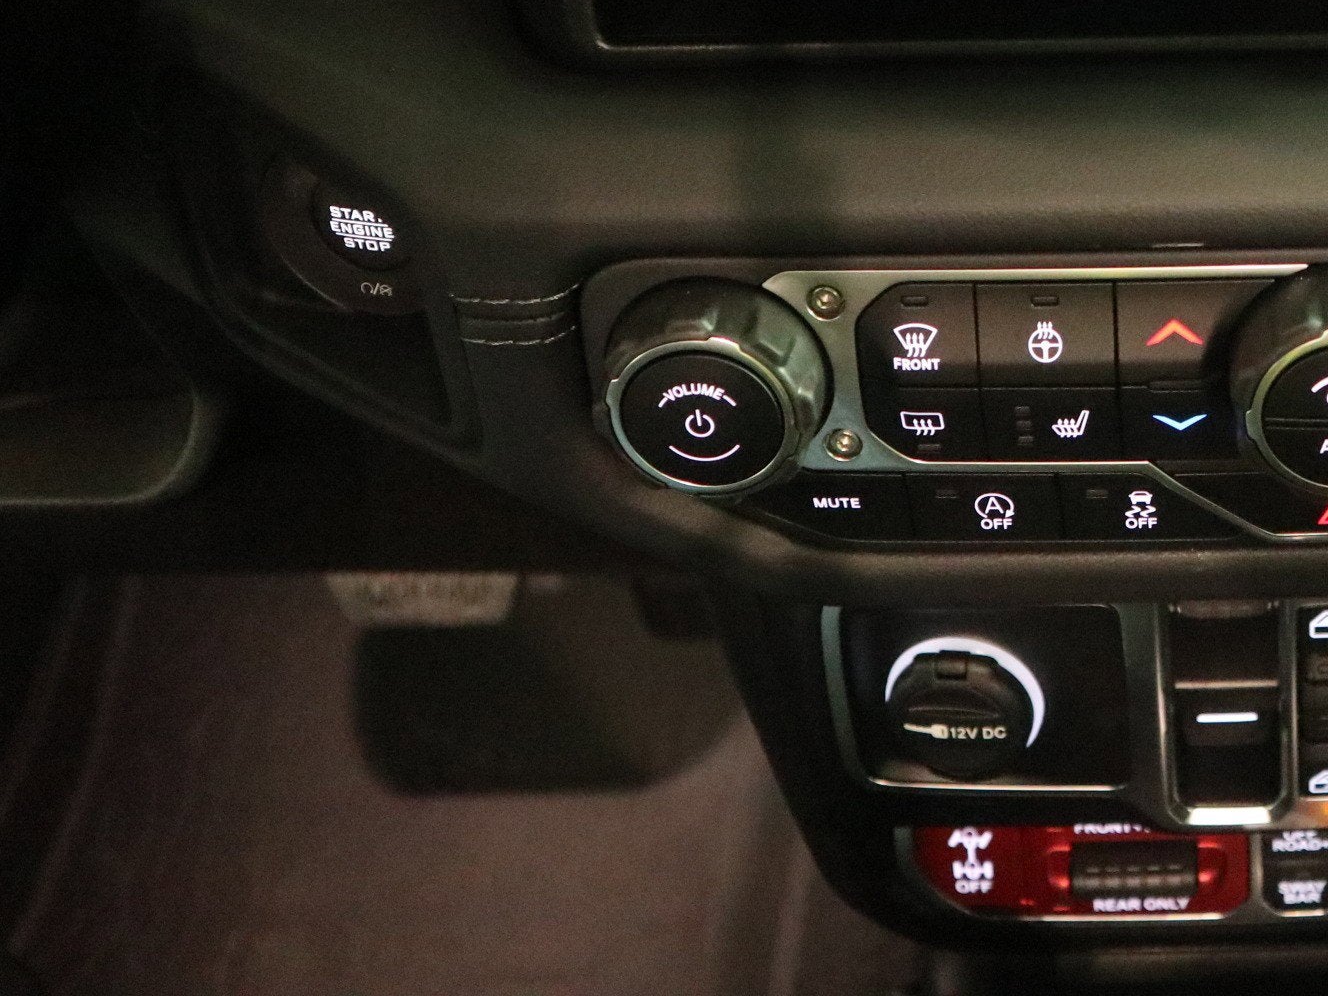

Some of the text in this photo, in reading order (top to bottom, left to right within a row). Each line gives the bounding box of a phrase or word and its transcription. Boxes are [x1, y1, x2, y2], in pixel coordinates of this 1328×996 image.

[329, 205, 383, 223] STAR
[330, 221, 395, 239] ENGINE
[344, 237, 391, 252] STOP
[893, 357, 940, 372] FRONT
[662, 383, 725, 402] VOLUME
[813, 497, 861, 509] MUTE
[980, 518, 1013, 530] OFF
[1125, 517, 1157, 529] OFF
[950, 726, 1007, 740] 12V DC
[955, 879, 992, 894] OFF
[1093, 897, 1191, 912] REAR ONLY
